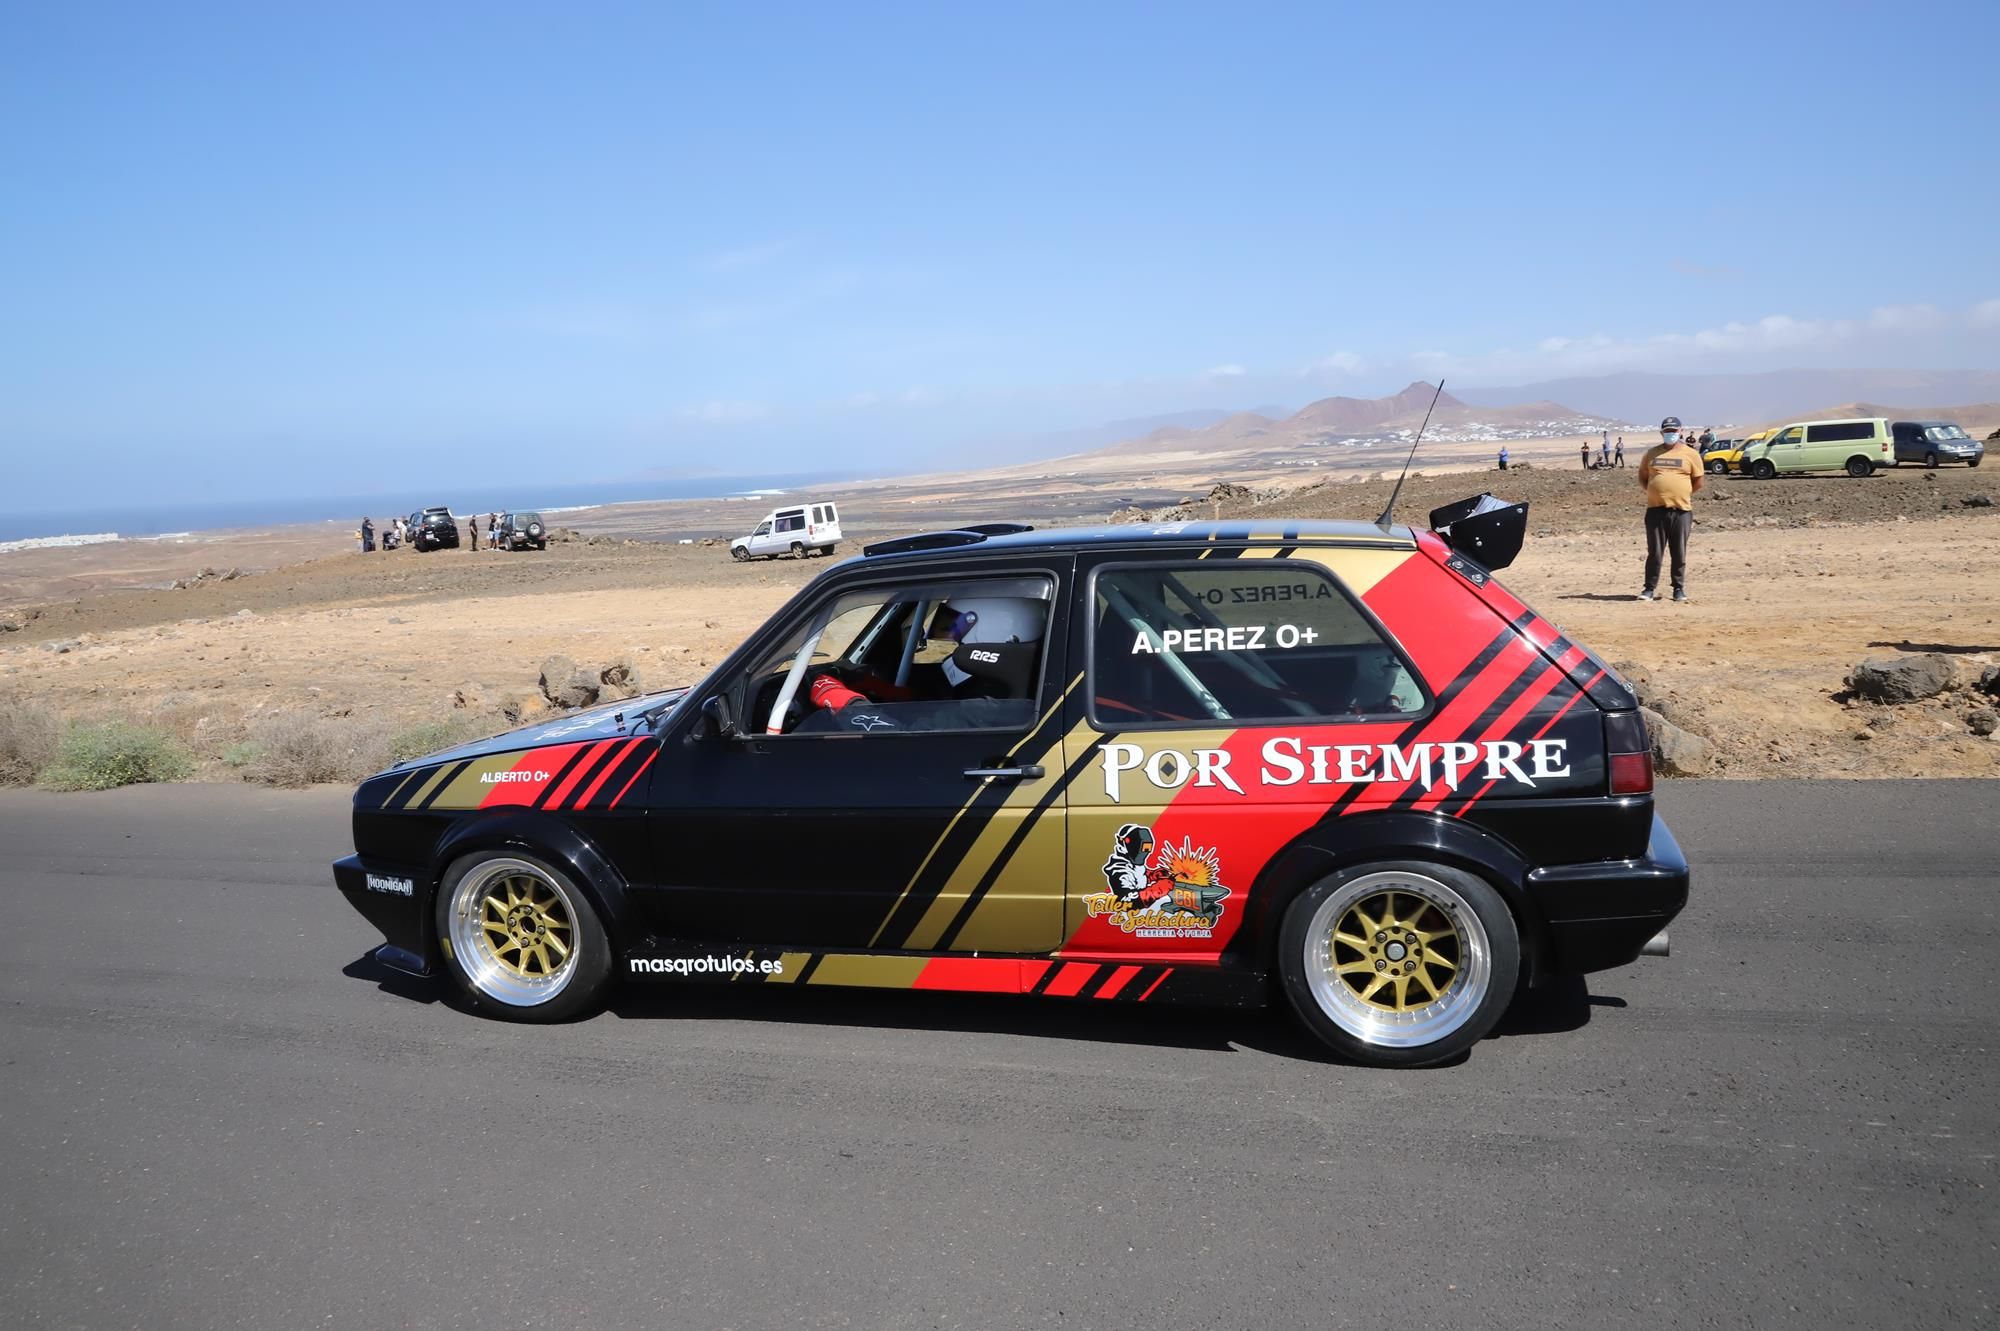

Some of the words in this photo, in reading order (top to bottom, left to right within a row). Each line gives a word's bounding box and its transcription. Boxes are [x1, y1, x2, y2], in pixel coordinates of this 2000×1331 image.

[1131, 625, 1266, 655] A.PEREZ
[1275, 624, 1319, 649] O+
[969, 649, 1000, 663] RRS
[480, 770, 532, 783] ALBERTO
[533, 770, 550, 782] O+
[1098, 743, 1246, 804] POR
[1260, 737, 1571, 793] SIEMPRE
[1085, 893, 1133, 916] Taller
[1112, 910, 1126, 924] de
[1122, 909, 1211, 931] Soldadura
[630, 954, 783, 976] masqrotulos.es
